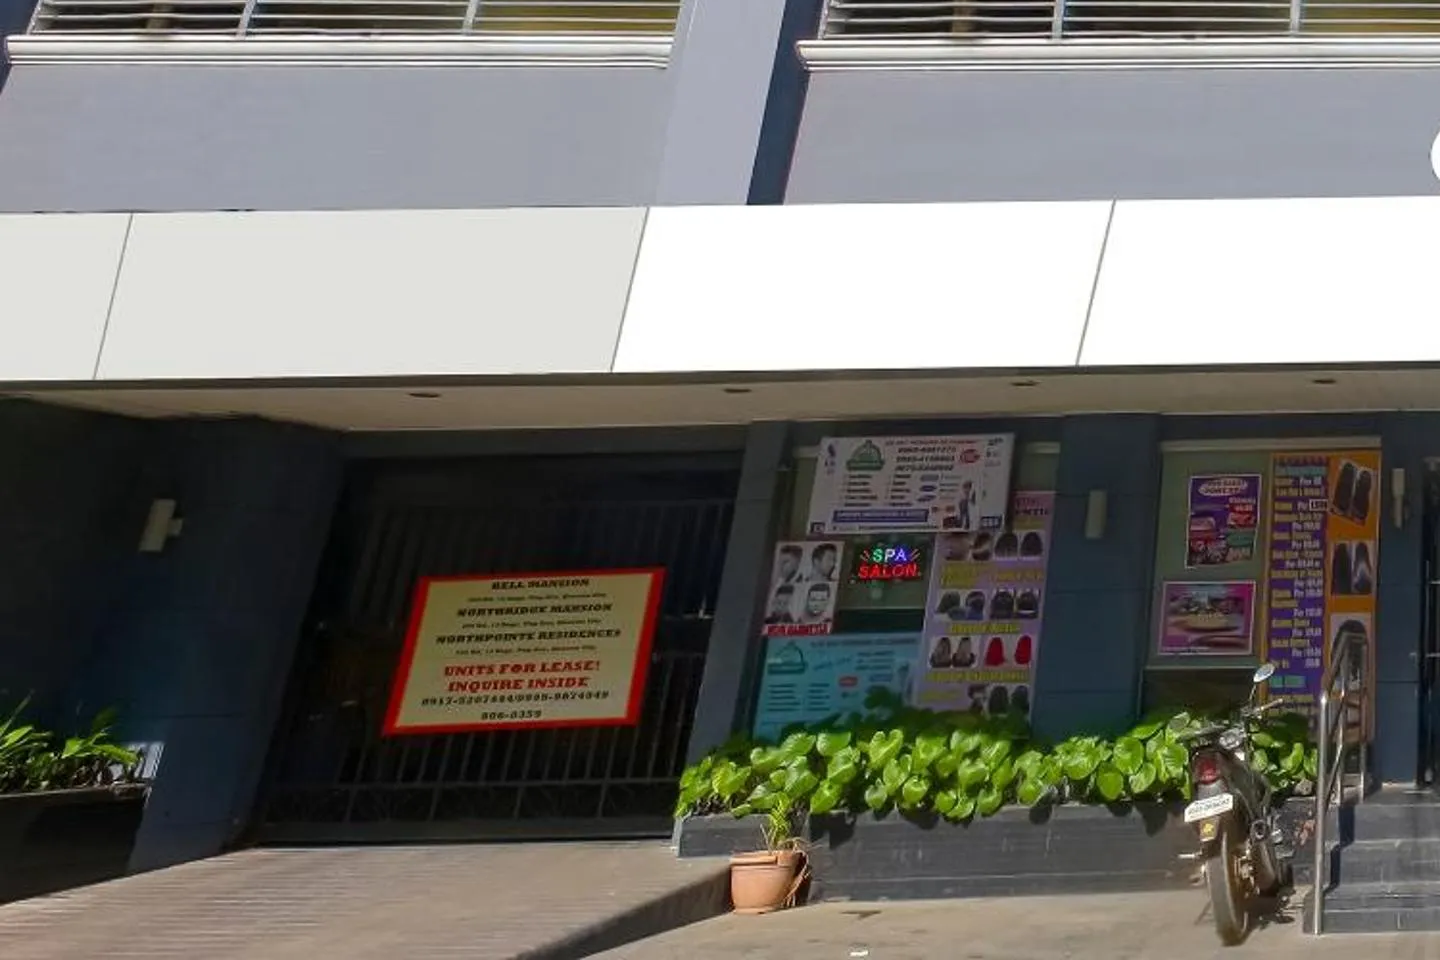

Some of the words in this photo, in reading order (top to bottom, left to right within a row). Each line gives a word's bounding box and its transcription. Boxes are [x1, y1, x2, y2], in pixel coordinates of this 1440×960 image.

[872, 547, 907, 564] SPA
[858, 563, 919, 579] SALON
[491, 580, 525, 590] BELL
[528, 578, 590, 589] MANSION
[550, 603, 613, 613] MANSION
[538, 629, 621, 641] RESIDENCES
[444, 664, 495, 677] UNITS
[498, 662, 536, 674] FOR
[539, 660, 601, 673] LEASE!
[448, 679, 523, 694] INQUIRE
[528, 676, 590, 689] INSIDE
